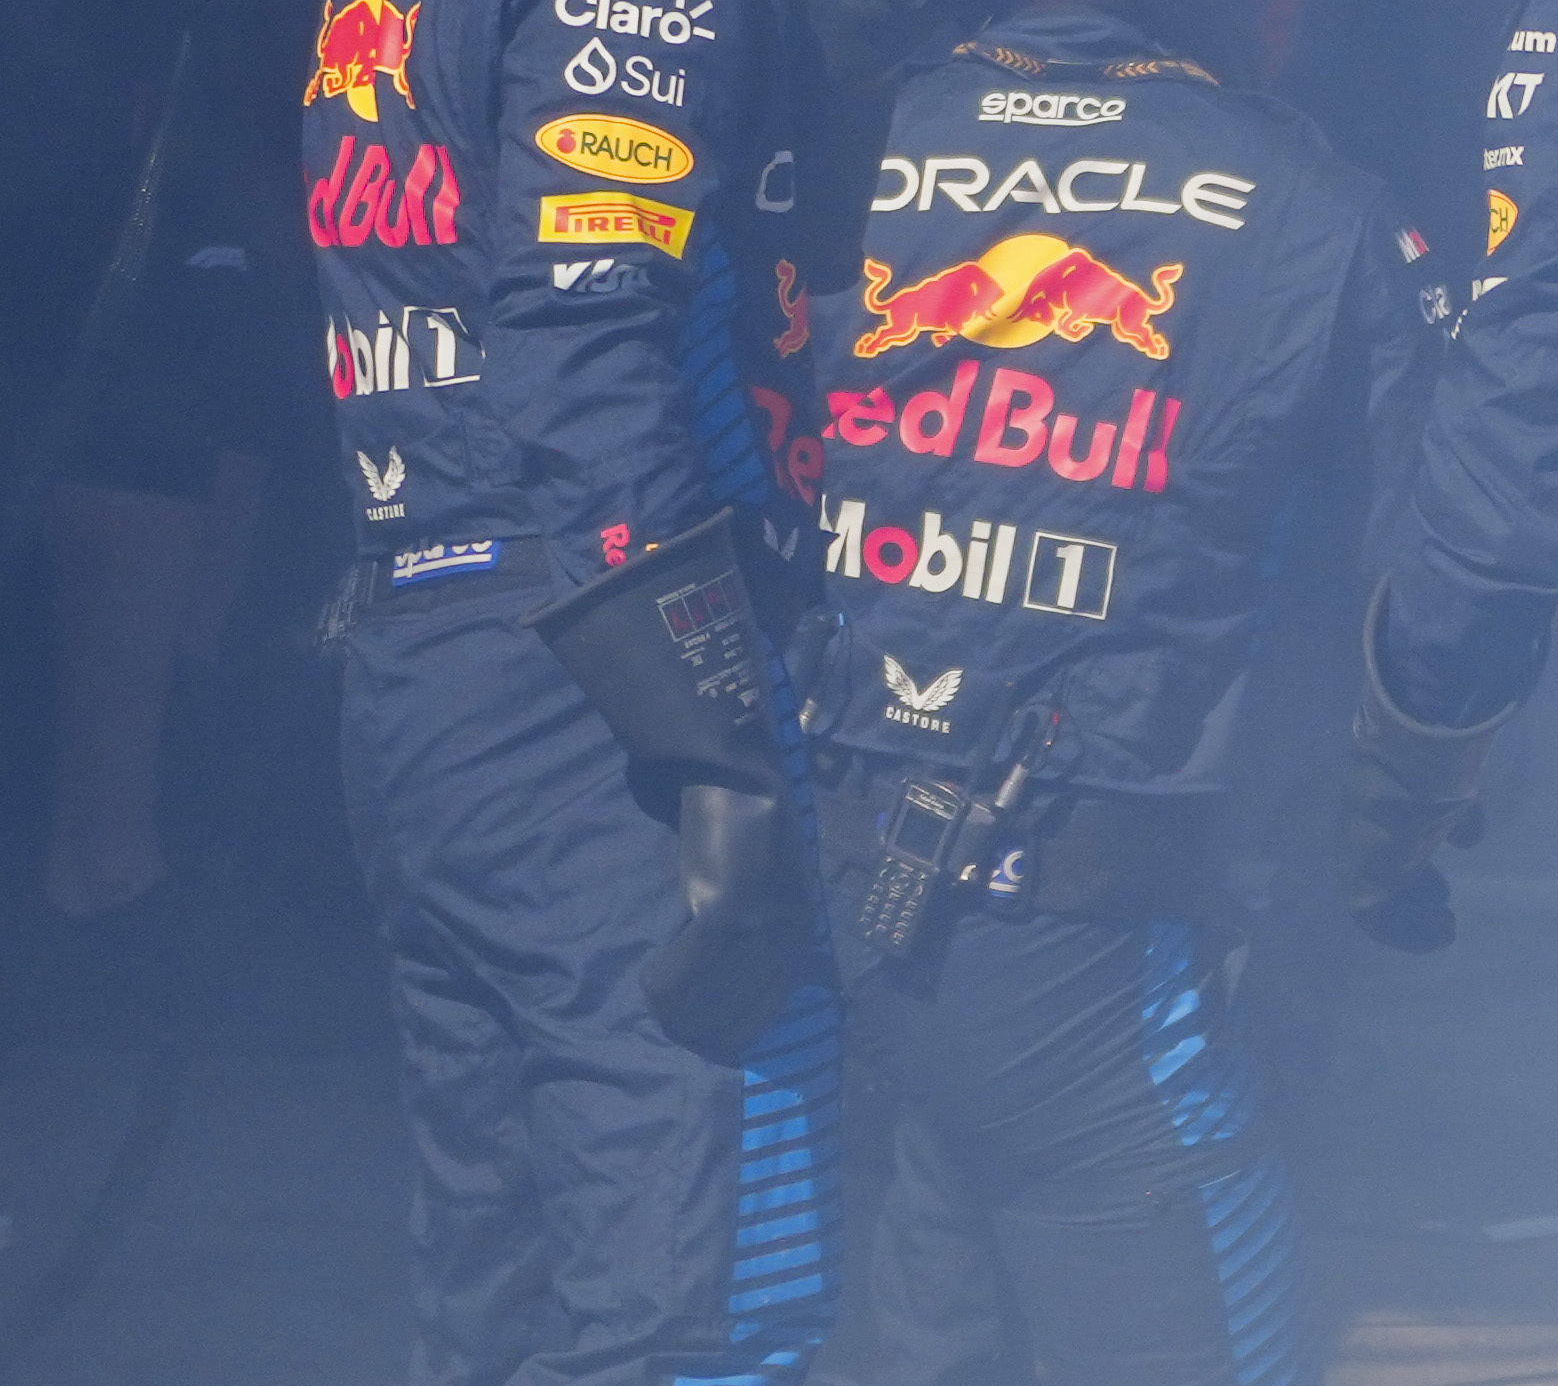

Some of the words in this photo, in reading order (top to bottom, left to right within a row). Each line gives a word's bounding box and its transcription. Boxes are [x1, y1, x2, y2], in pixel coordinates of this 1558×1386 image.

[620, 55, 687, 108] Sui
[979, 91, 1126, 126] sparco
[579, 130, 674, 172] RAUCH
[553, 204, 677, 247] PIRELLI
[974, 367, 1182, 494] Bull
[885, 705, 951, 746] CASTORE
